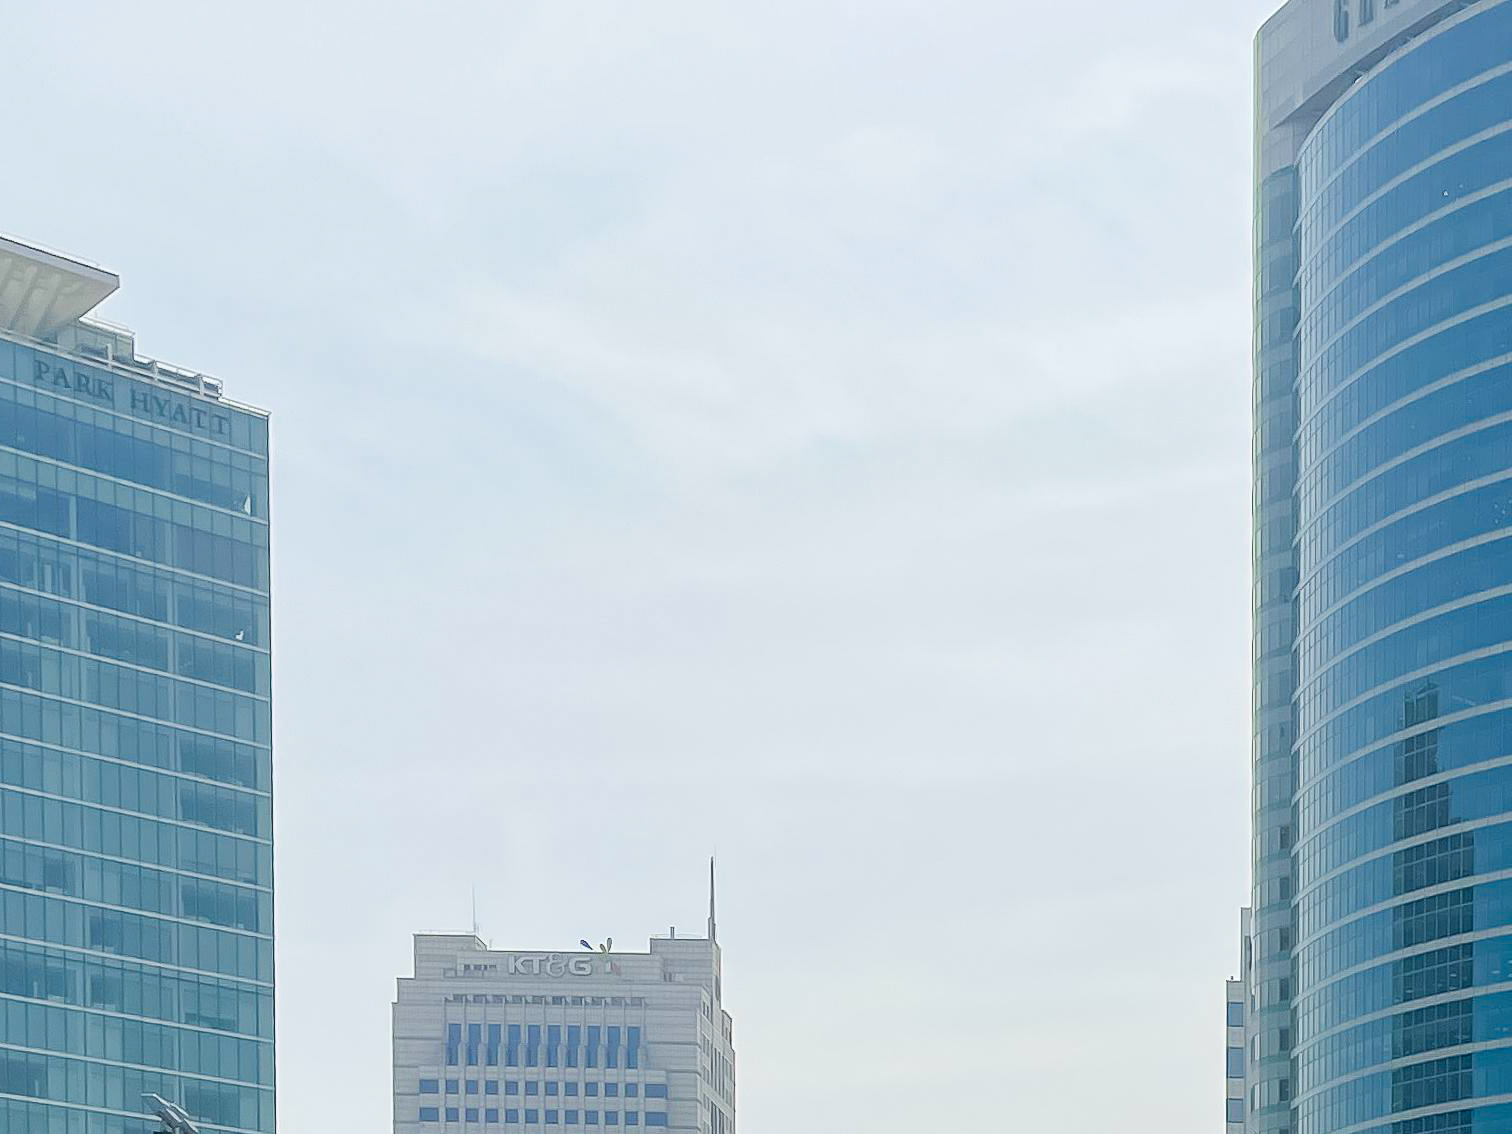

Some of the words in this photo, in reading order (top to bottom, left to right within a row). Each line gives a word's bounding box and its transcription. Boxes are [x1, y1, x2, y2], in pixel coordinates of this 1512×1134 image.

[34, 360, 114, 400] PARK
[129, 387, 229, 435] HYATT
[508, 953, 592, 978] KT&G
